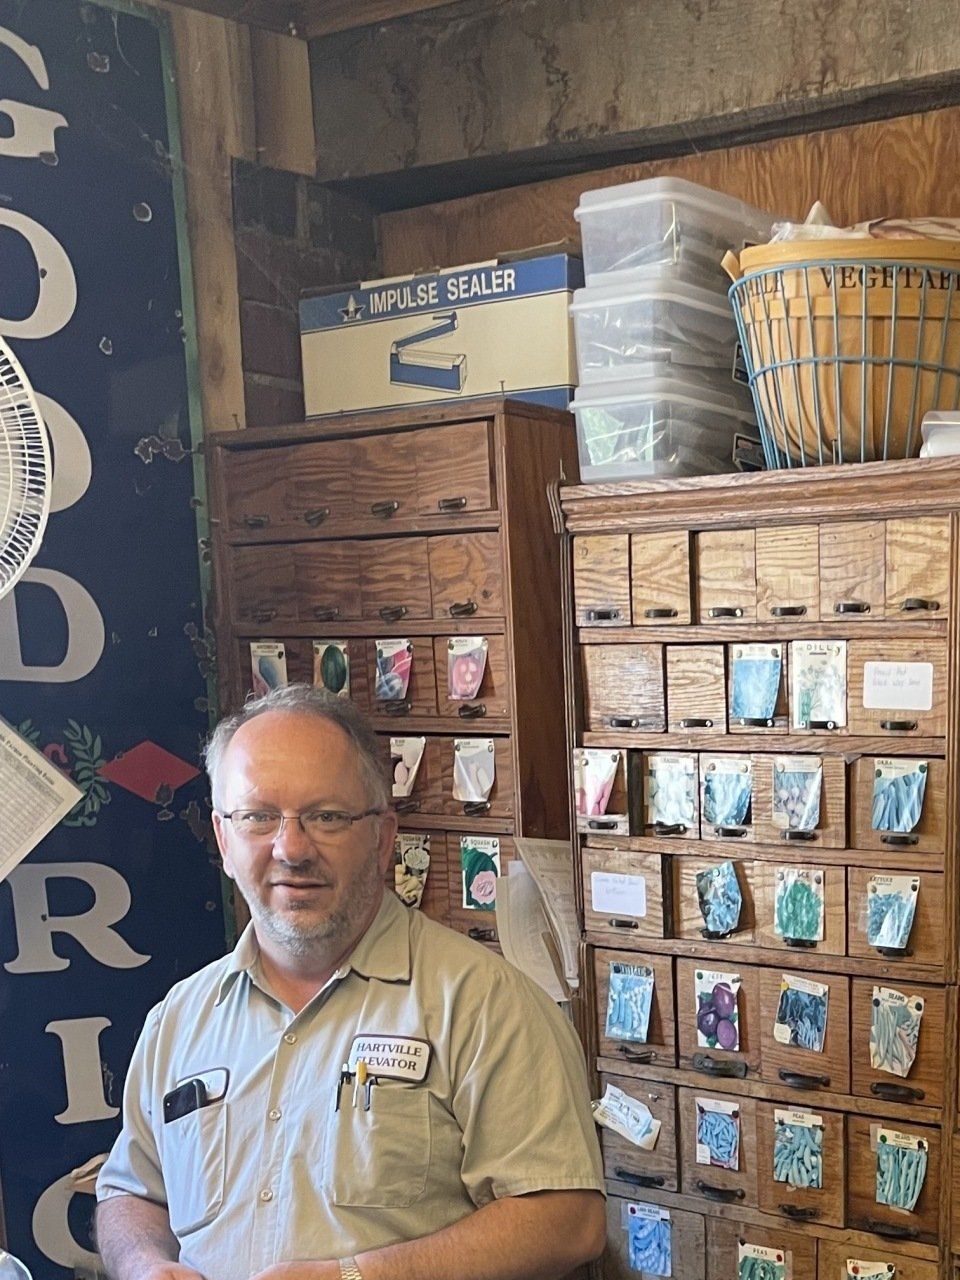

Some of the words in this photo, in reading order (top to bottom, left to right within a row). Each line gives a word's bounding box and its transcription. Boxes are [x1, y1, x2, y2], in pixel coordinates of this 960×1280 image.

[370, 281, 439, 314] IMPULSE
[447, 268, 516, 301] SEALER
[356, 1042, 422, 1057] HARTVILLE
[355, 1055, 418, 1072] ELEVATOR
[895, 1134, 911, 1142] BEANS
[752, 1248, 768, 1257] PEAS
